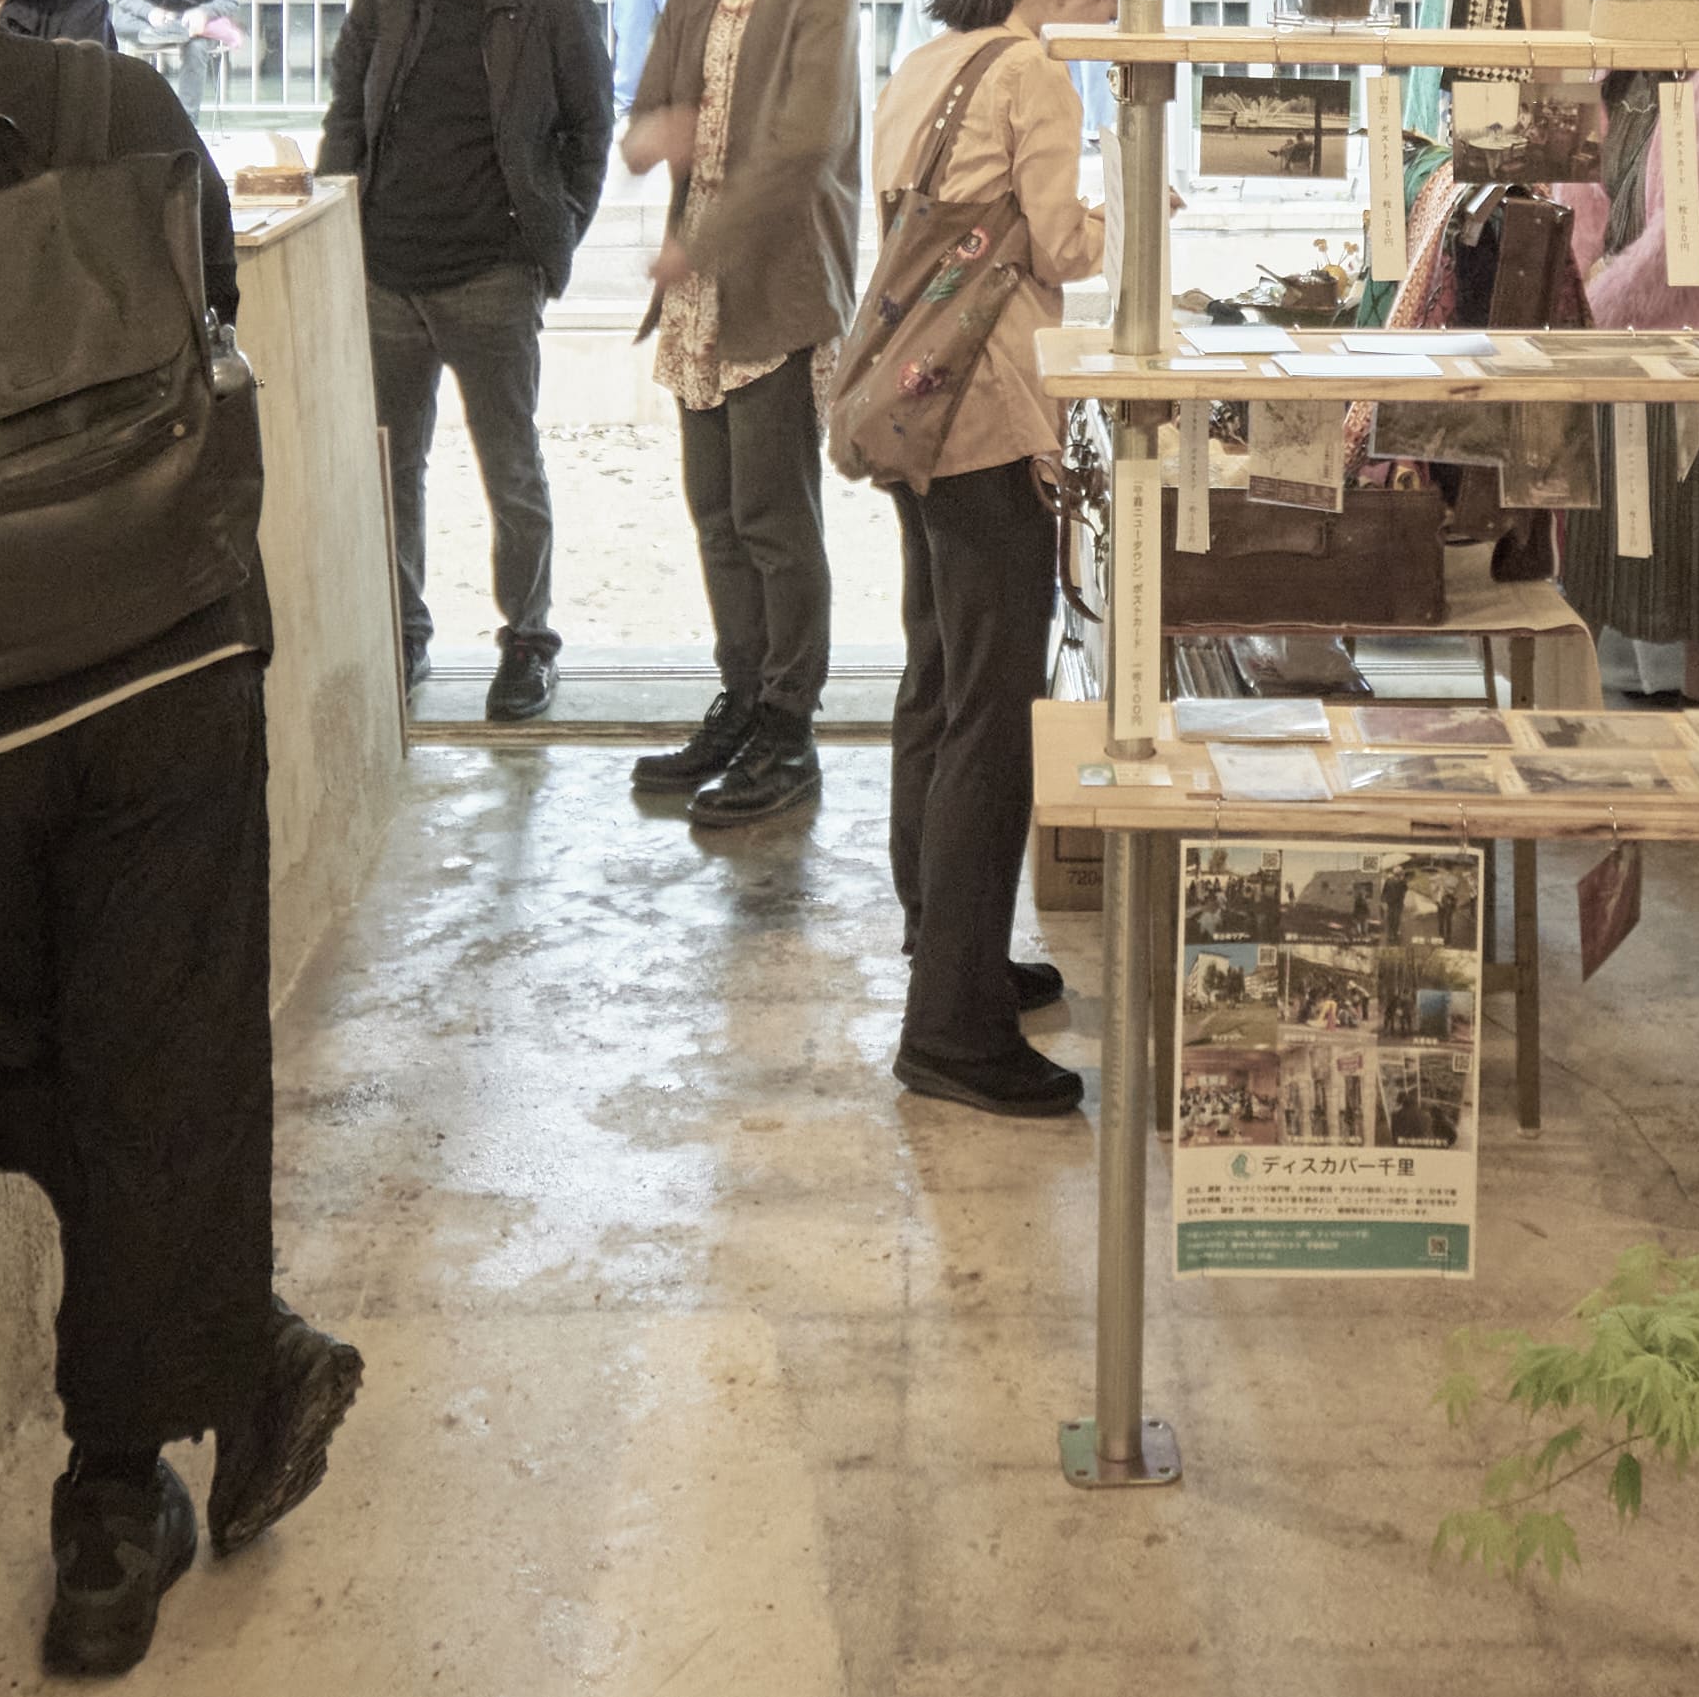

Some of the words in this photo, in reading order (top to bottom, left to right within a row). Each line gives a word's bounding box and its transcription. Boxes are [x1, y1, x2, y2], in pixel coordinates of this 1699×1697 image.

[1067, 869, 1103, 887] 720
[1261, 1157, 1416, 1177] ディスカバー千里
